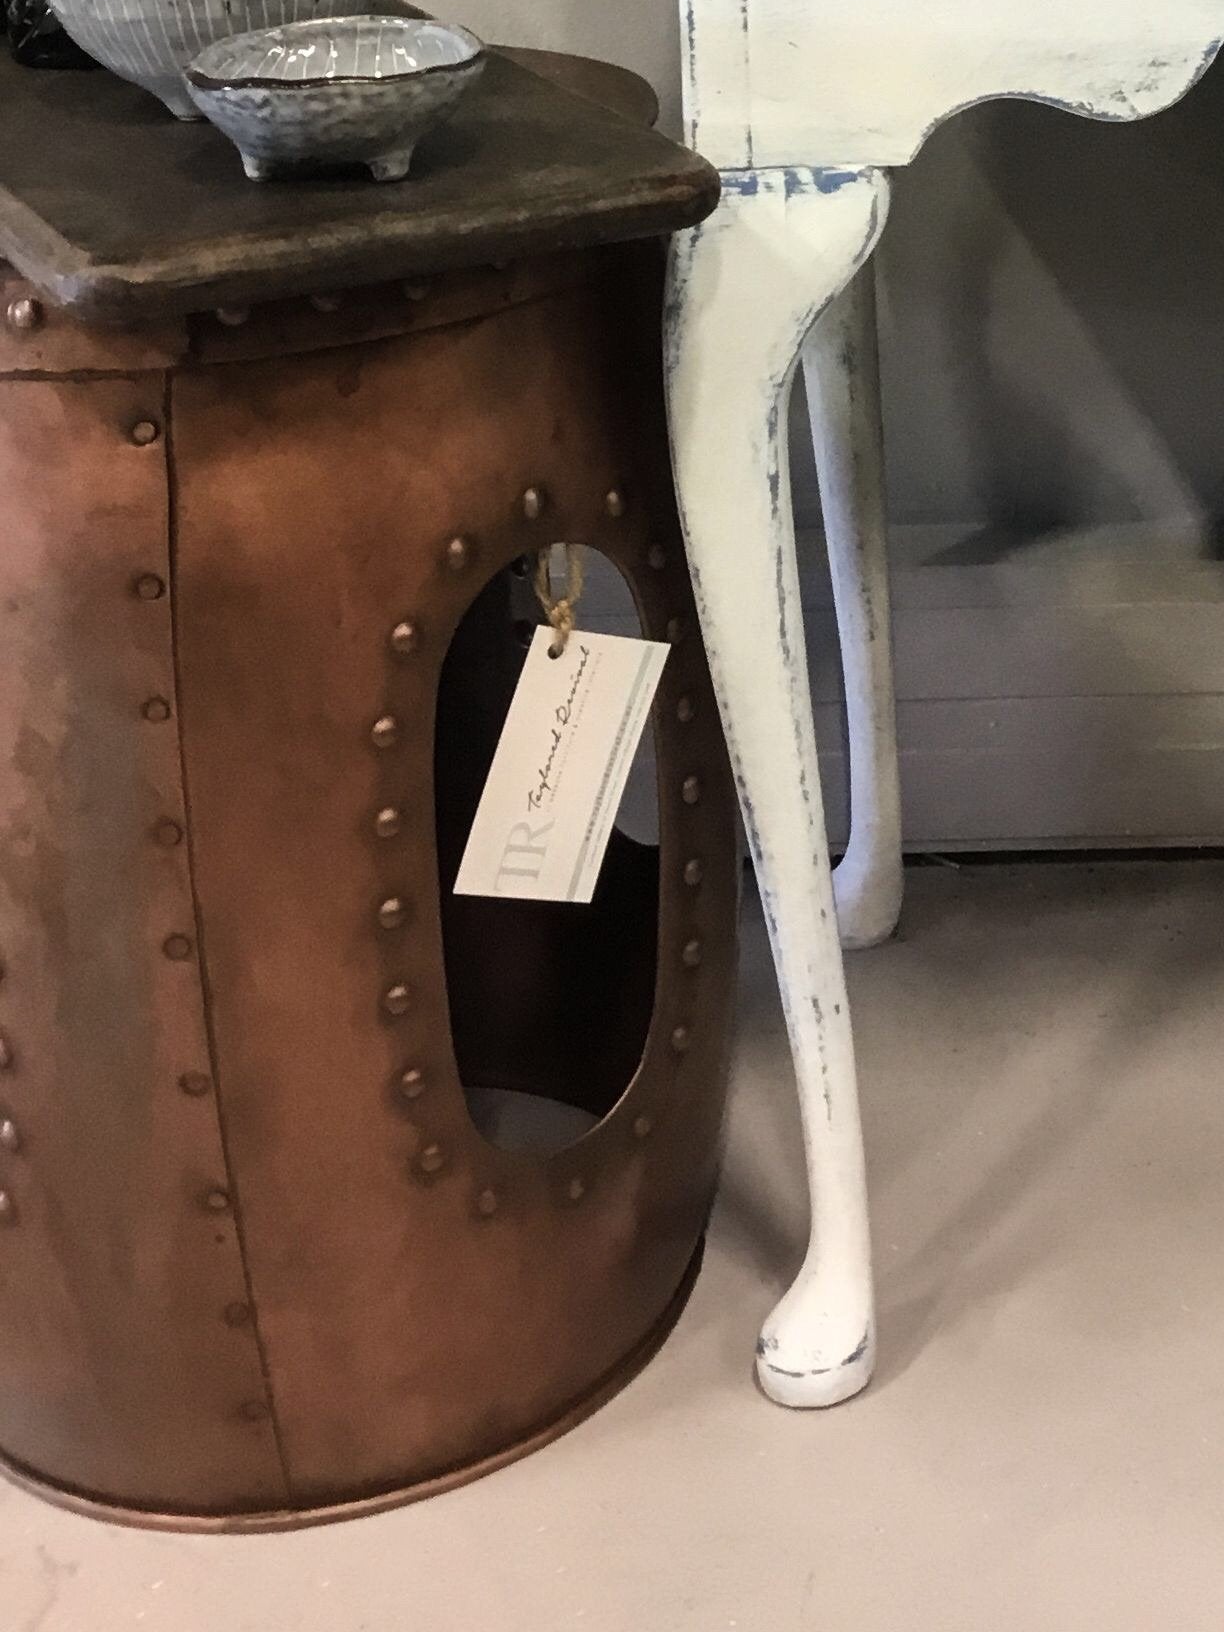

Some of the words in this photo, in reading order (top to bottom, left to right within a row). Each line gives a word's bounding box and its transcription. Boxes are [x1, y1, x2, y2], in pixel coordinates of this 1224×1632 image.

[528, 730, 563, 812] Taylored
[555, 645, 590, 726] Revival
[493, 817, 555, 893] TR
